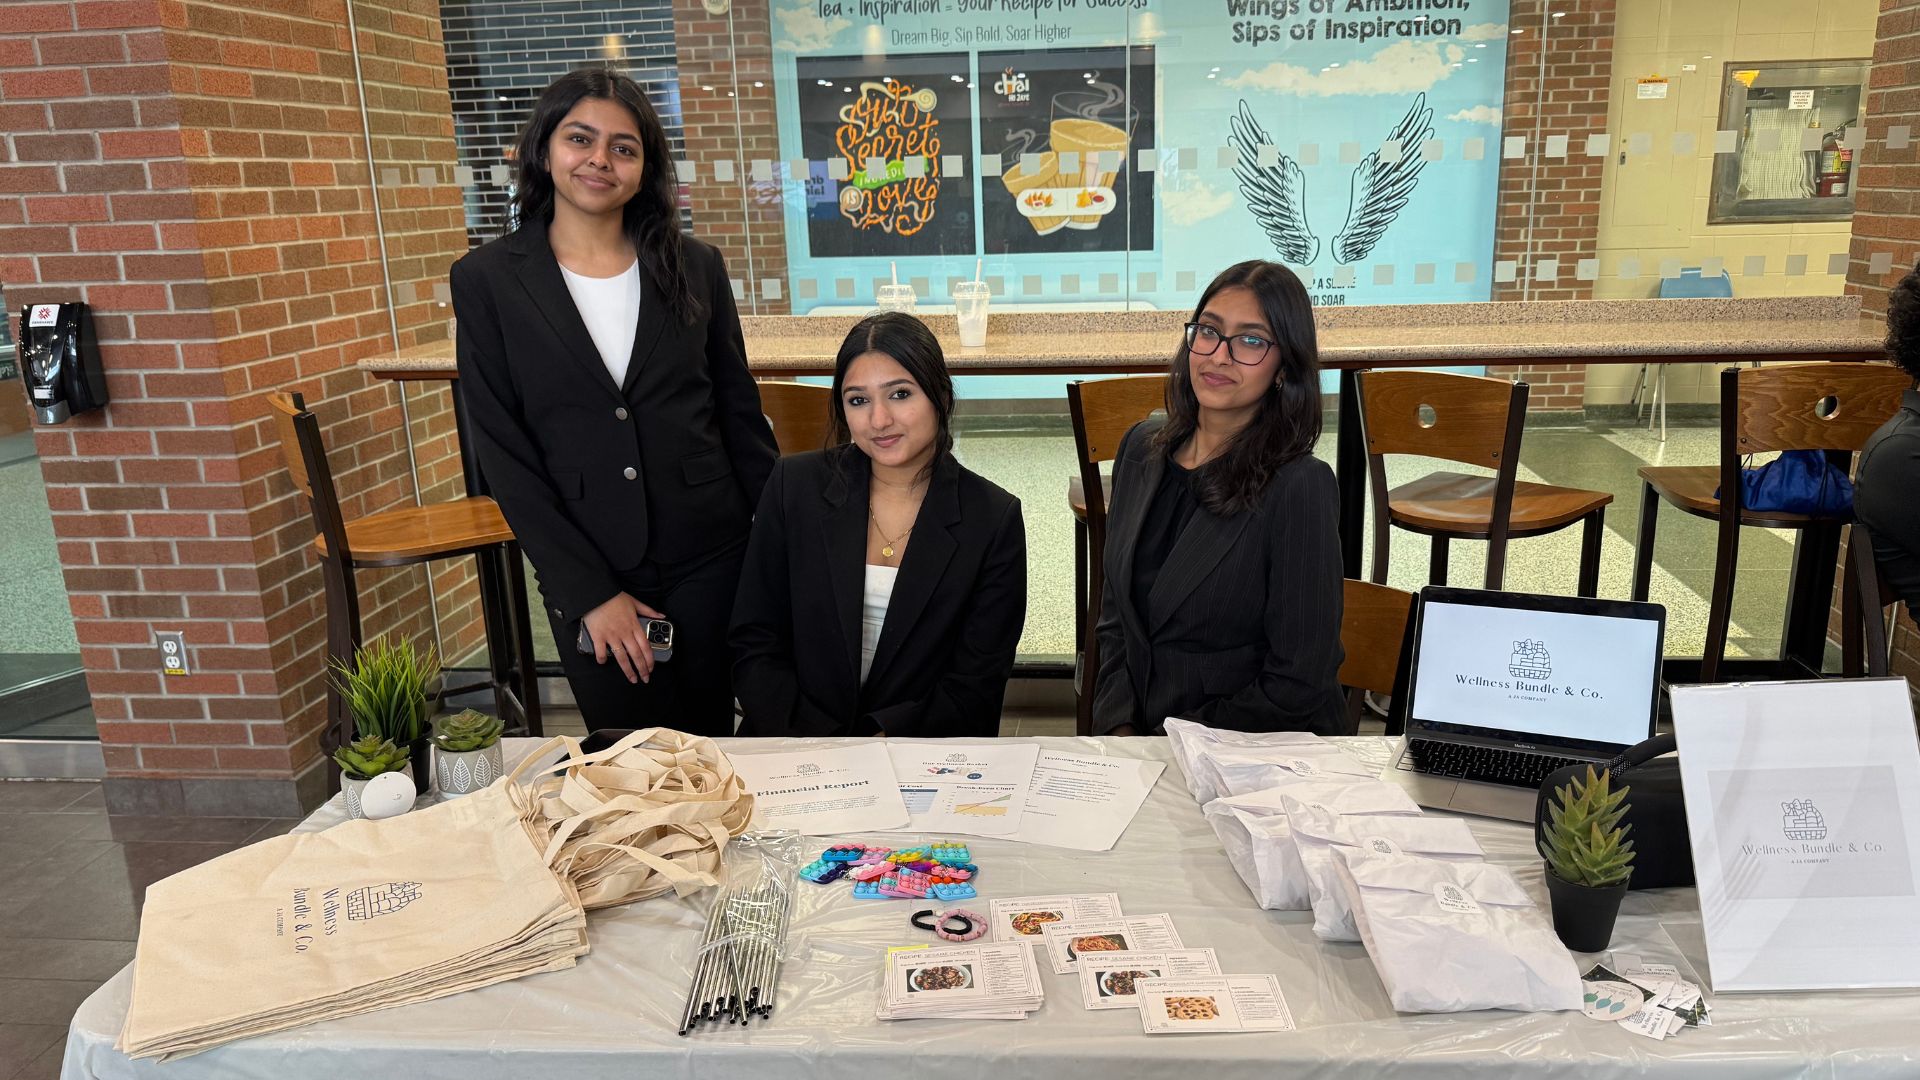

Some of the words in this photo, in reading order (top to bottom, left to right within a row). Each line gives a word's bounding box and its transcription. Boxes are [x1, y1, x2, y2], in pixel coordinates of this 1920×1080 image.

[859, 0, 940, 25] Inspiration
[1227, 0, 1299, 20] Wings
[1309, 0, 1333, 14] of
[1345, 0, 1470, 12] Ambition,
[891, 29, 927, 46] Dream
[930, 27, 951, 47] Big,
[955, 27, 973, 45] Sip
[976, 26, 1002, 43] Bold,
[1006, 25, 1031, 41] Soar
[1034, 24, 1072, 43] Higher
[1232, 20, 1281, 47] Sips
[1290, 19, 1316, 40] of
[1325, 14, 1462, 43] Inspiration
[1321, 294, 1345, 306] SOAR
[1455, 674, 1511, 690] Wellness
[1516, 680, 1559, 695] Bundle
[1564, 685, 1575, 697] &
[1580, 686, 1604, 700] Co.
[1520, 695, 1548, 703] COMPANY
[757, 785, 821, 797] Financial
[824, 780, 870, 791] Report
[1741, 844, 1798, 857] Wellness
[1801, 841, 1842, 855] Bundle
[1848, 841, 1859, 853] &
[294, 887, 312, 920] Bundle
[322, 887, 341, 936] Wellness
[295, 923, 313, 932] &
[295, 936, 314, 954] Co.
